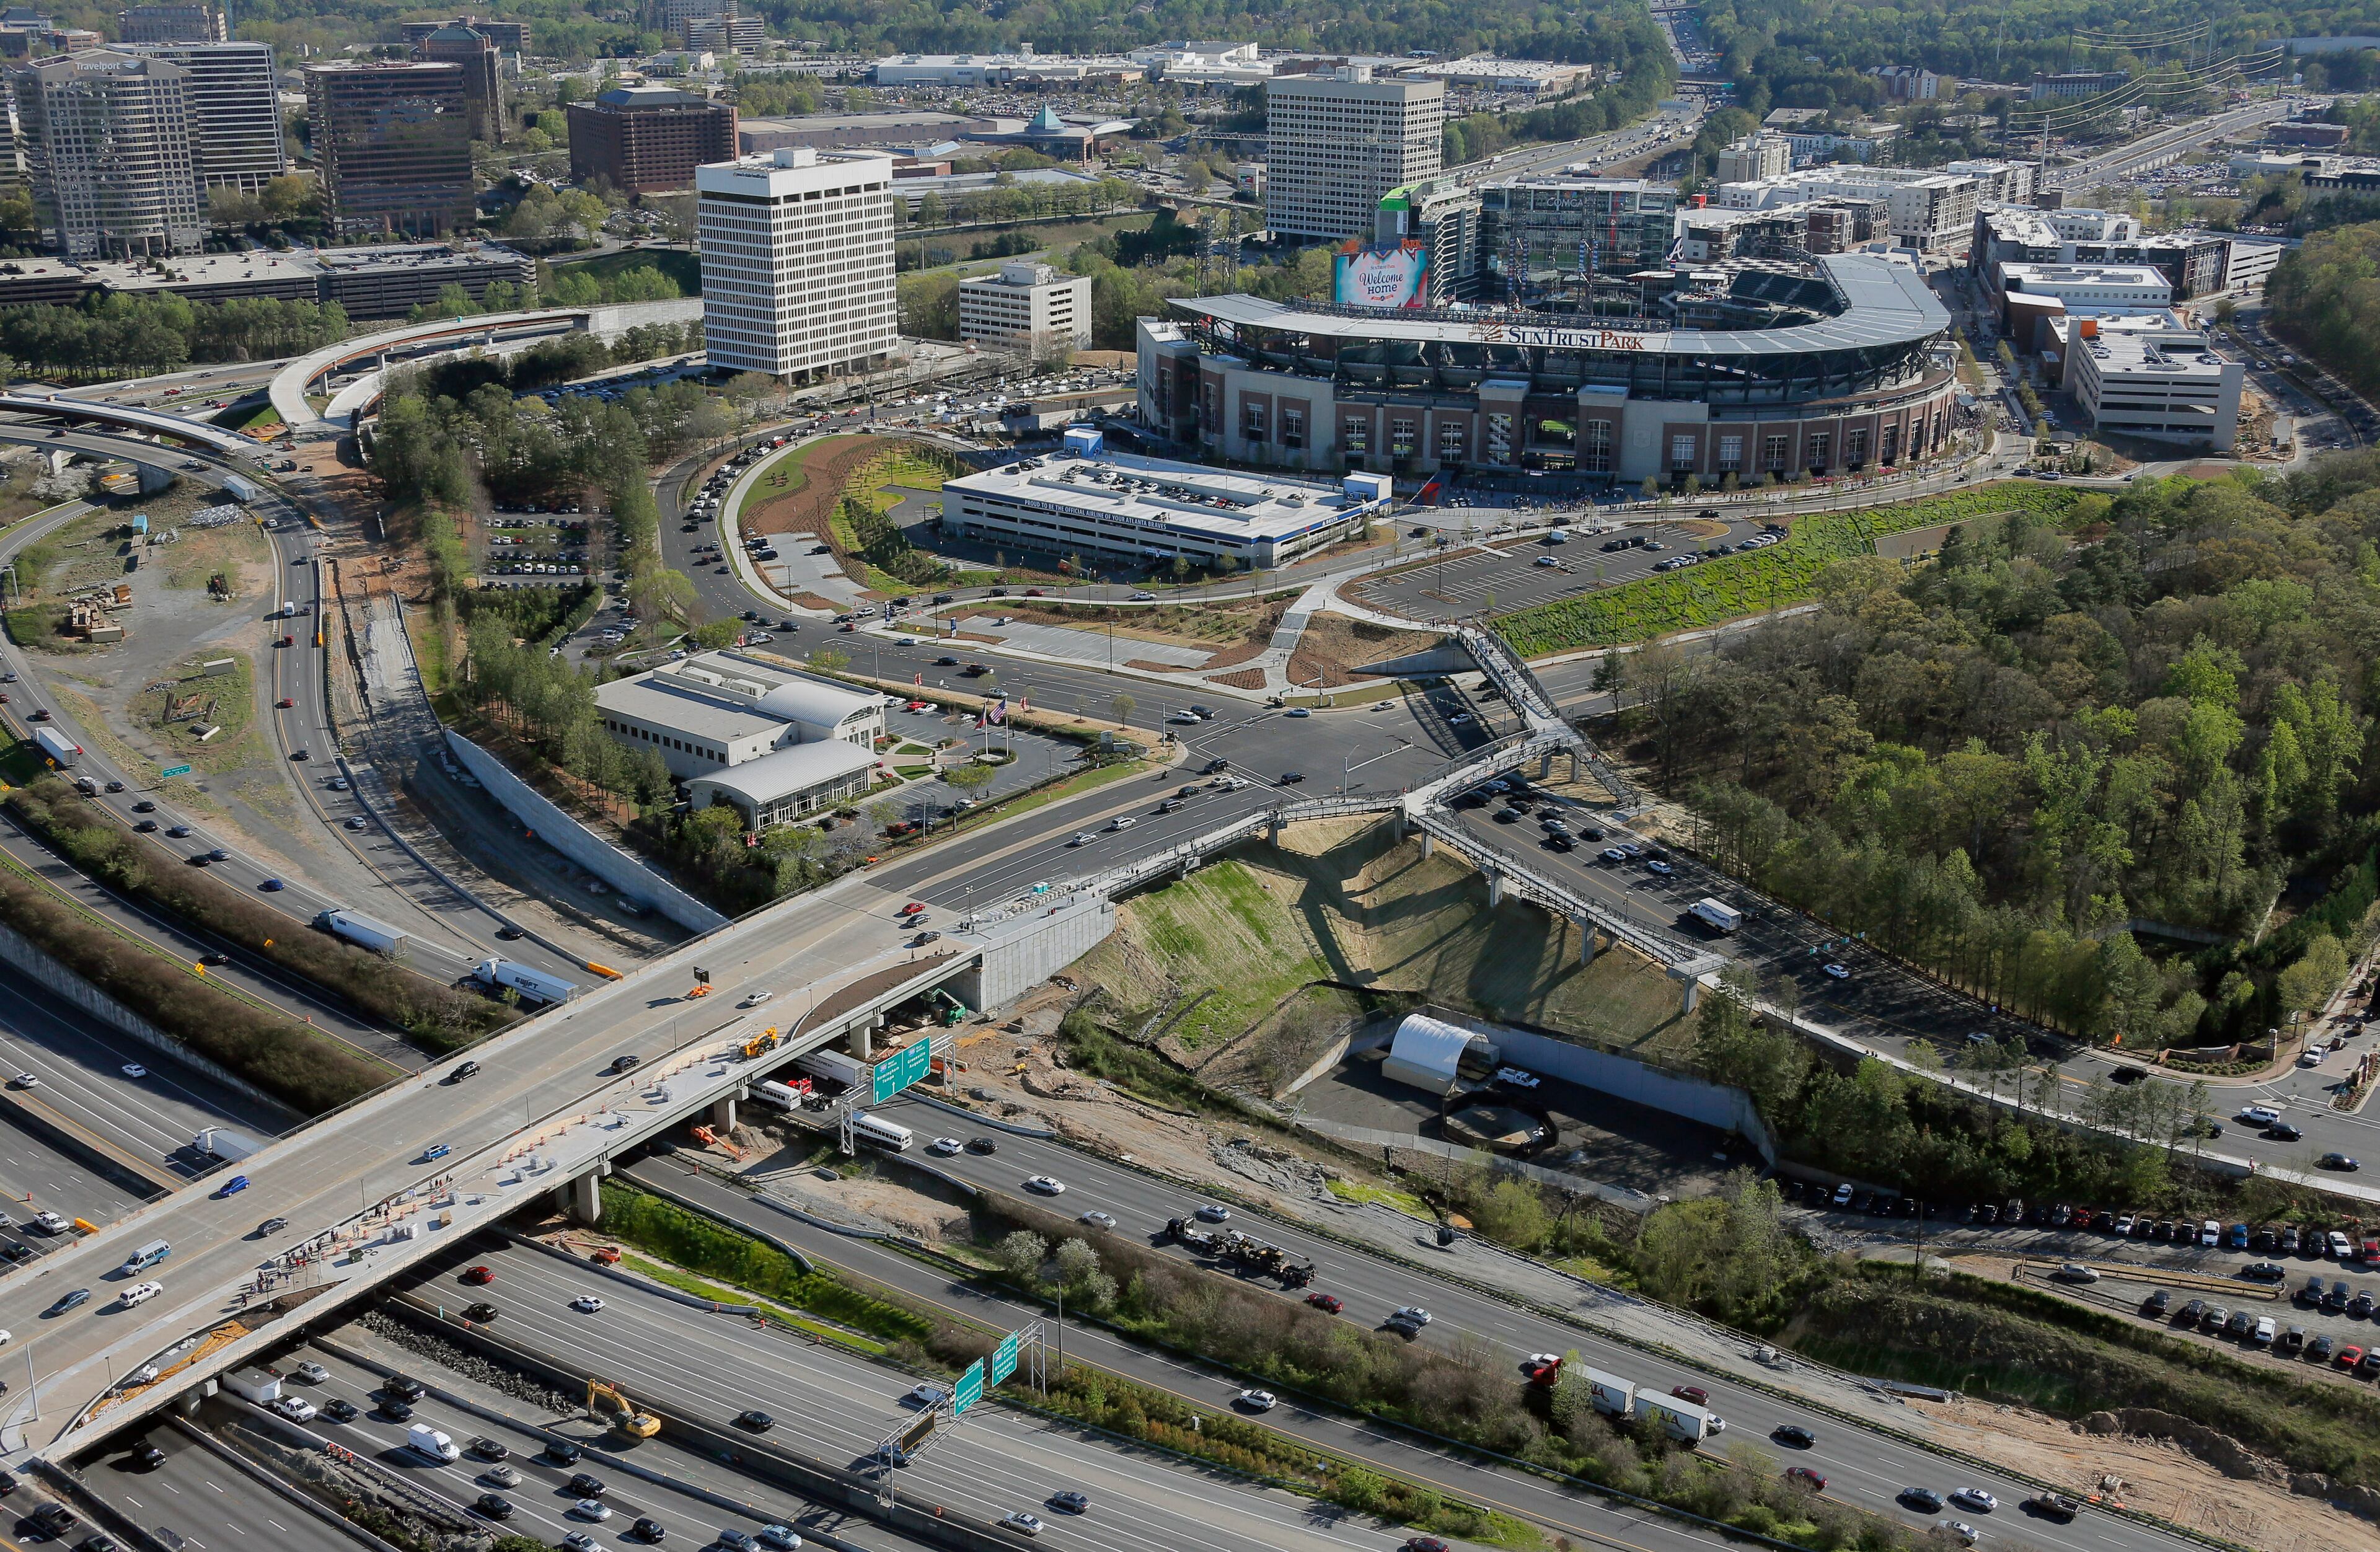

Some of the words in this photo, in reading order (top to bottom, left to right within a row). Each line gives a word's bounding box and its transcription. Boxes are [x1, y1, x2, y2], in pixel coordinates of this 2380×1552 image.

[75, 61, 120, 71] Travelport
[1547, 198, 1583, 207] COMCA
[1359, 271, 1403, 286] Welcome
[1025, 500, 1041, 508] PROUD
[1065, 506, 1085, 516] OFFICIAL
[1086, 510, 1104, 519] AIRLINE
[1112, 514, 1125, 522] YOUR
[1126, 517, 1147, 526] ATLANTA
[1148, 521, 1166, 530] BRAVES
[1326, 516, 1338, 524] DELTA
[514, 977, 539, 989] SWIFT
[816, 1059, 833, 1068] EXPRESS
[907, 1051, 926, 1064] Greenville
[909, 1058, 924, 1068] Augusta
[877, 1067, 899, 1081] Birmingham
[883, 1075, 894, 1083] Tampa
[995, 1353, 1015, 1371] Greenville
[997, 1360, 1013, 1376] Augusta
[957, 1379, 981, 1401] Cumberland
[958, 1387, 979, 1407] Boulevard
